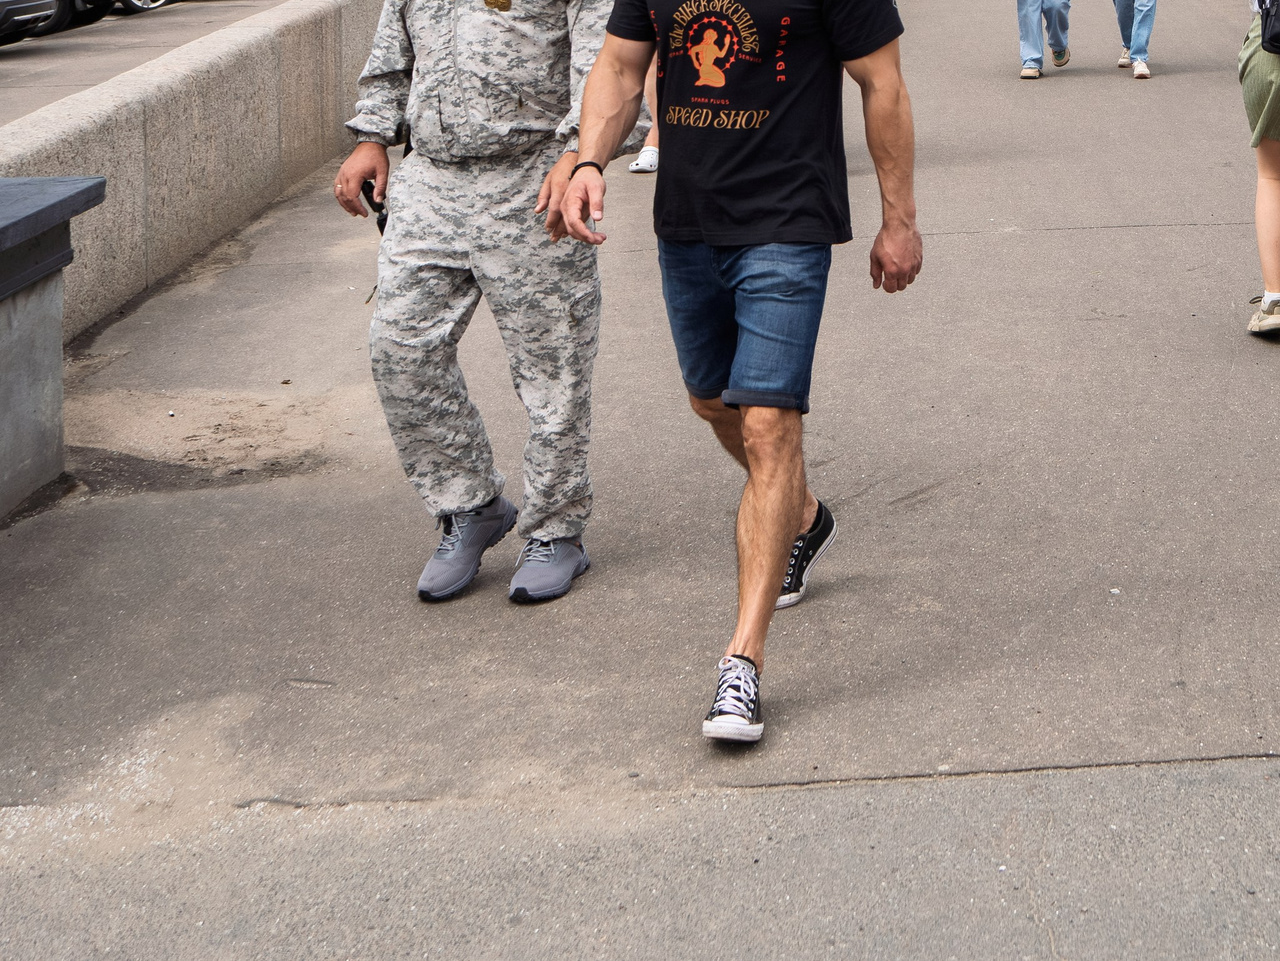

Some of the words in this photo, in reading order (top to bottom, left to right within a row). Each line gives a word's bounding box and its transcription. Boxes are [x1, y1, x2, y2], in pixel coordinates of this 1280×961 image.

[669, 24, 685, 49] The
[775, 16, 791, 83] GARAGE
[665, 105, 713, 128] SPEED
[713, 109, 770, 130] SHOP
